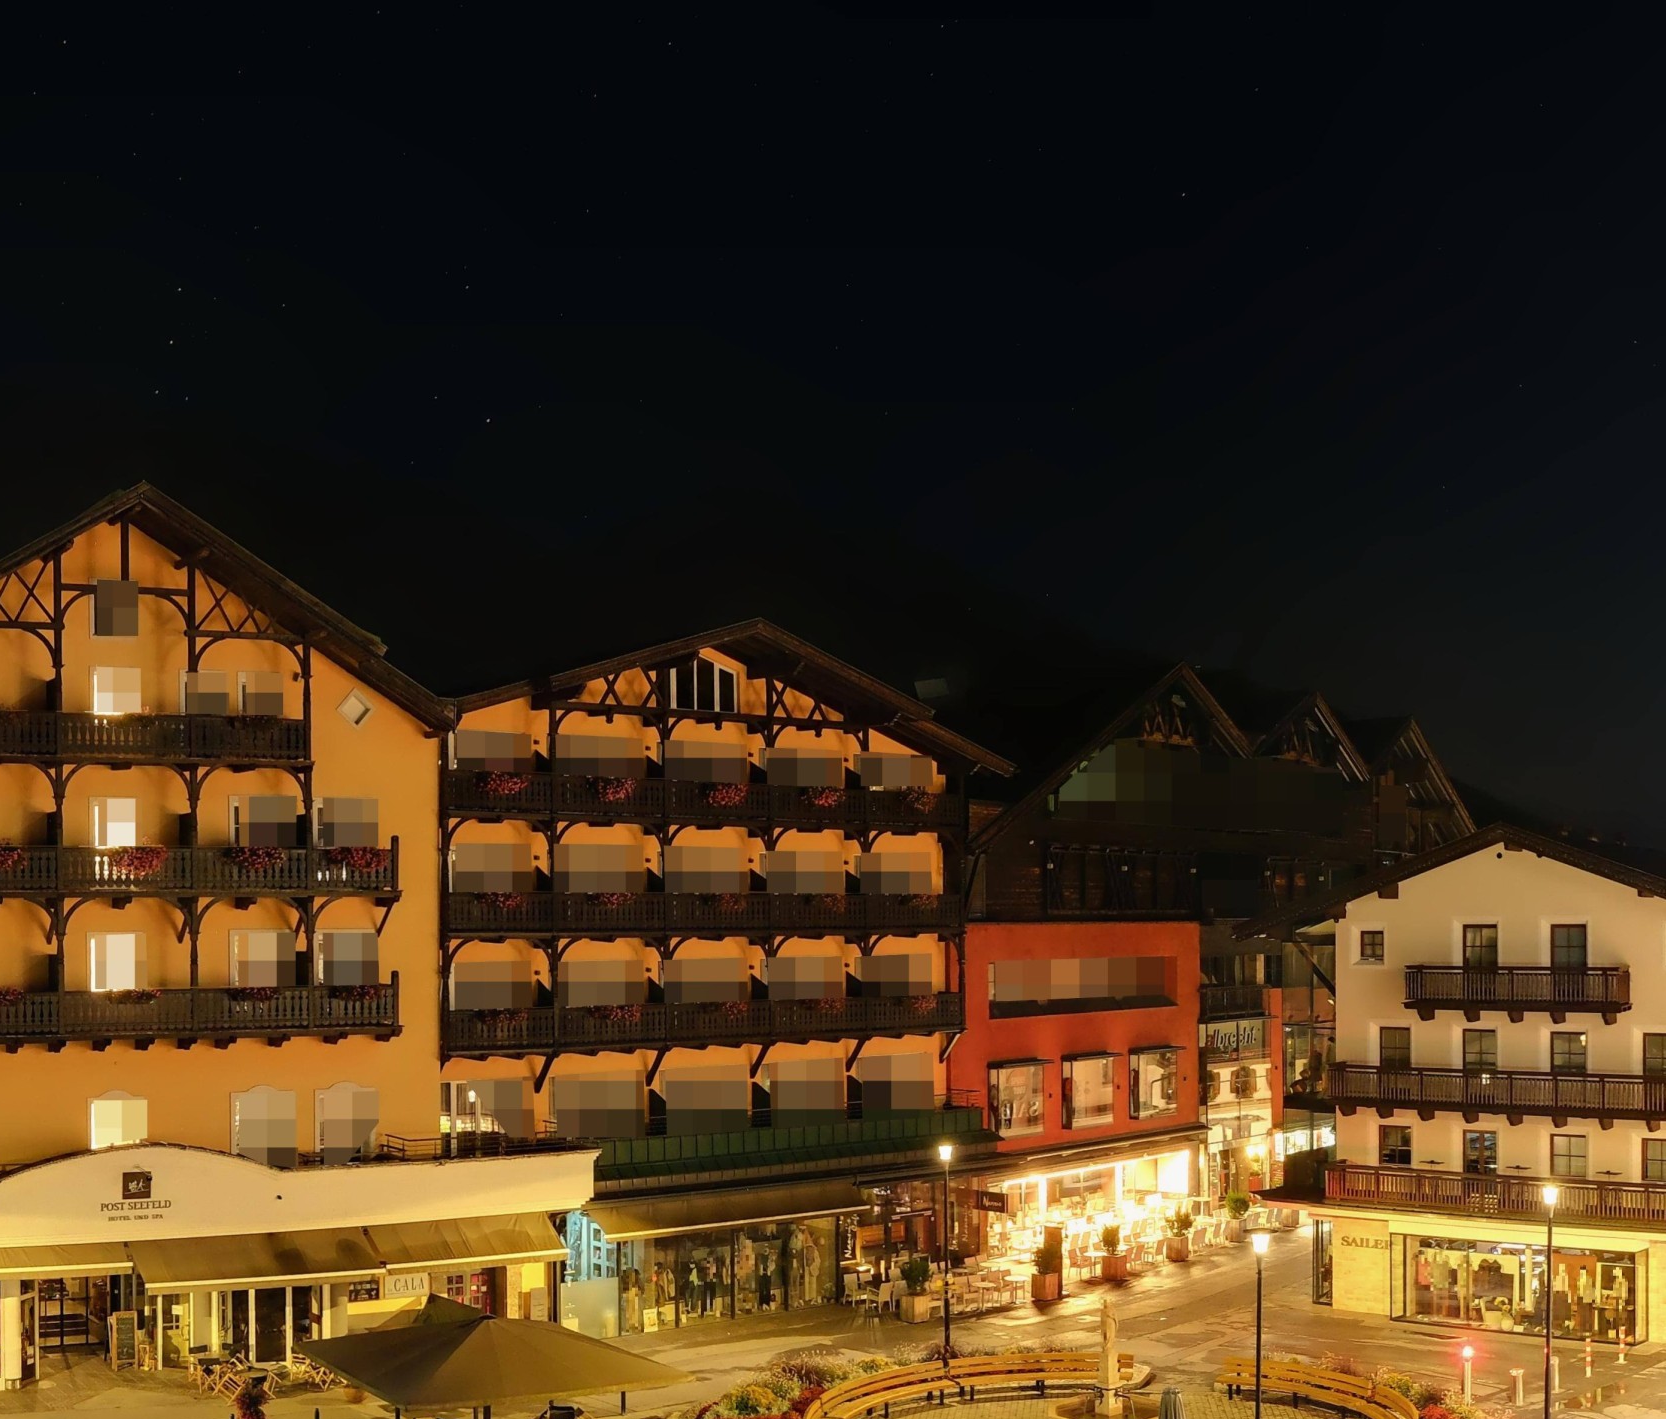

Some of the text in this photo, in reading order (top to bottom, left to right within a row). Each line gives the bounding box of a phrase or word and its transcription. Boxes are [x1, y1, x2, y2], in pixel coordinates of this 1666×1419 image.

[100, 1200, 172, 1212] POST SEEFELD
[393, 1276, 426, 1293] CALA
